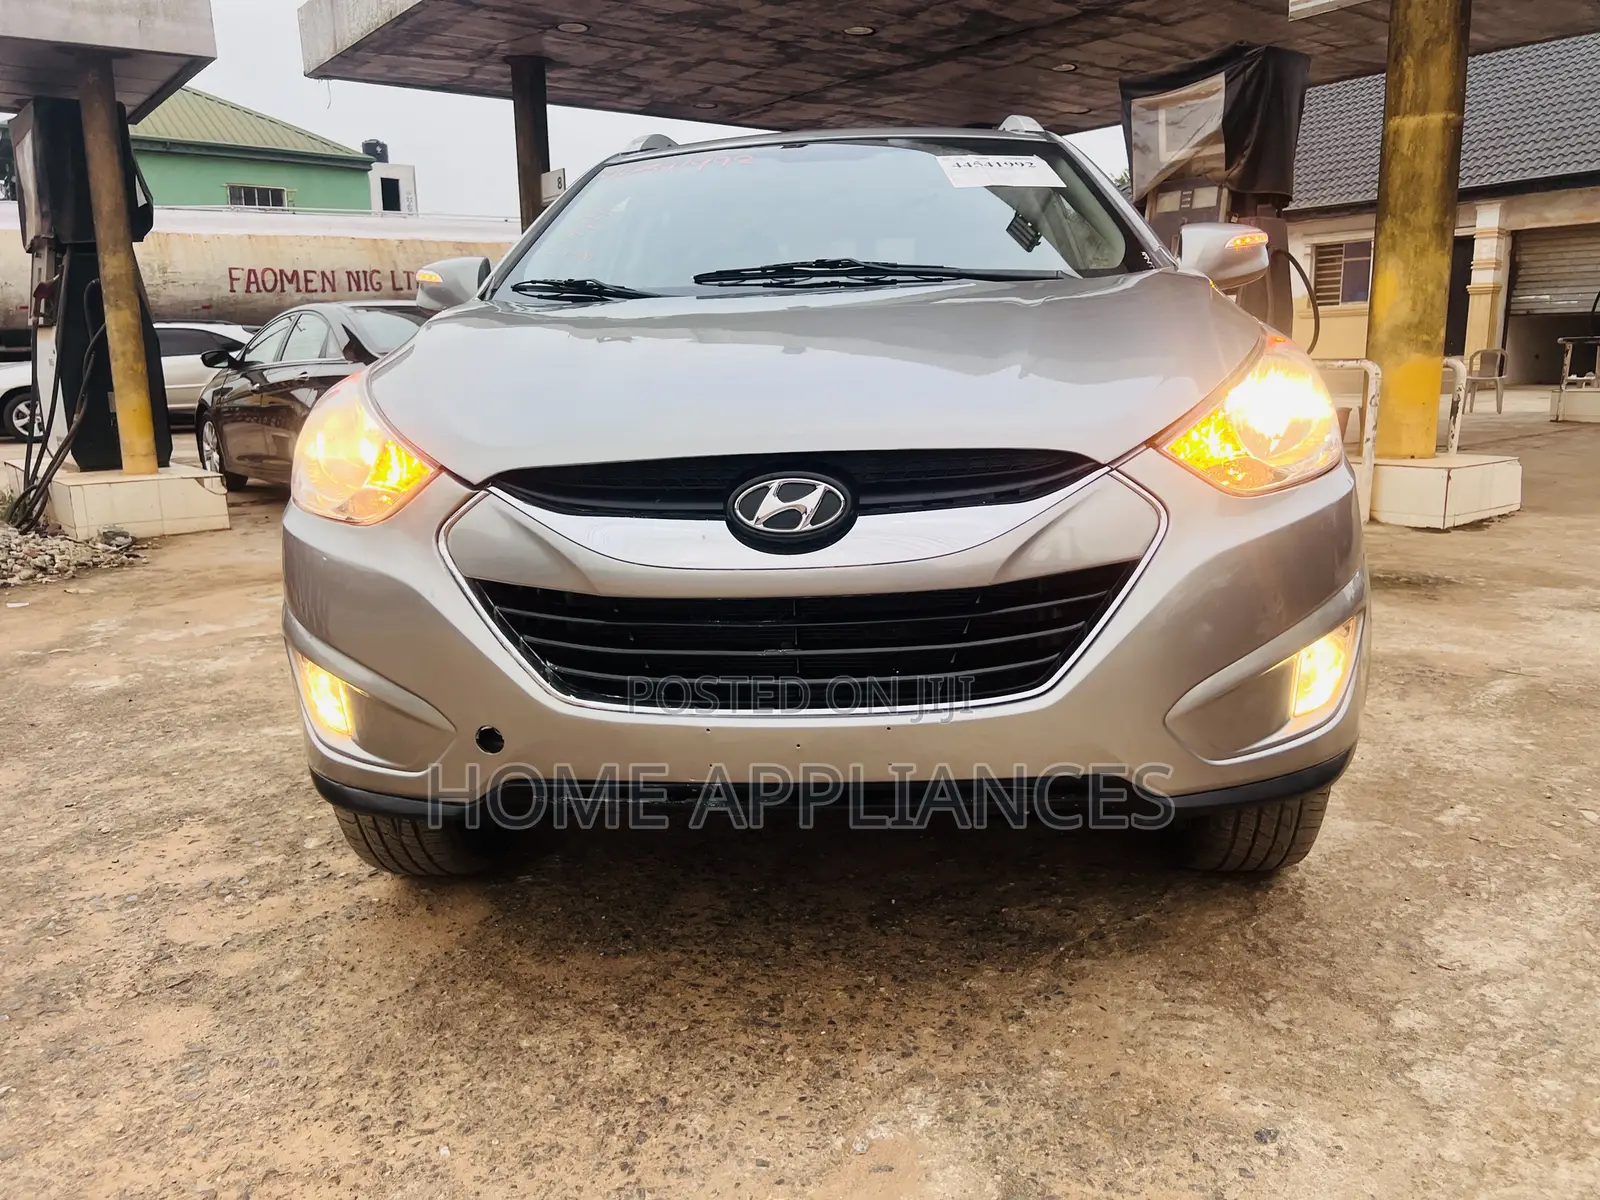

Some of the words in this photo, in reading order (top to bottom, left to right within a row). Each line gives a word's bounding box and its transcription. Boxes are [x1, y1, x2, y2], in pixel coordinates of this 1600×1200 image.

[557, 176, 563, 190] 8
[228, 267, 337, 293] FAOMEN
[345, 269, 383, 292] NIG
[390, 270, 419, 291] LT
